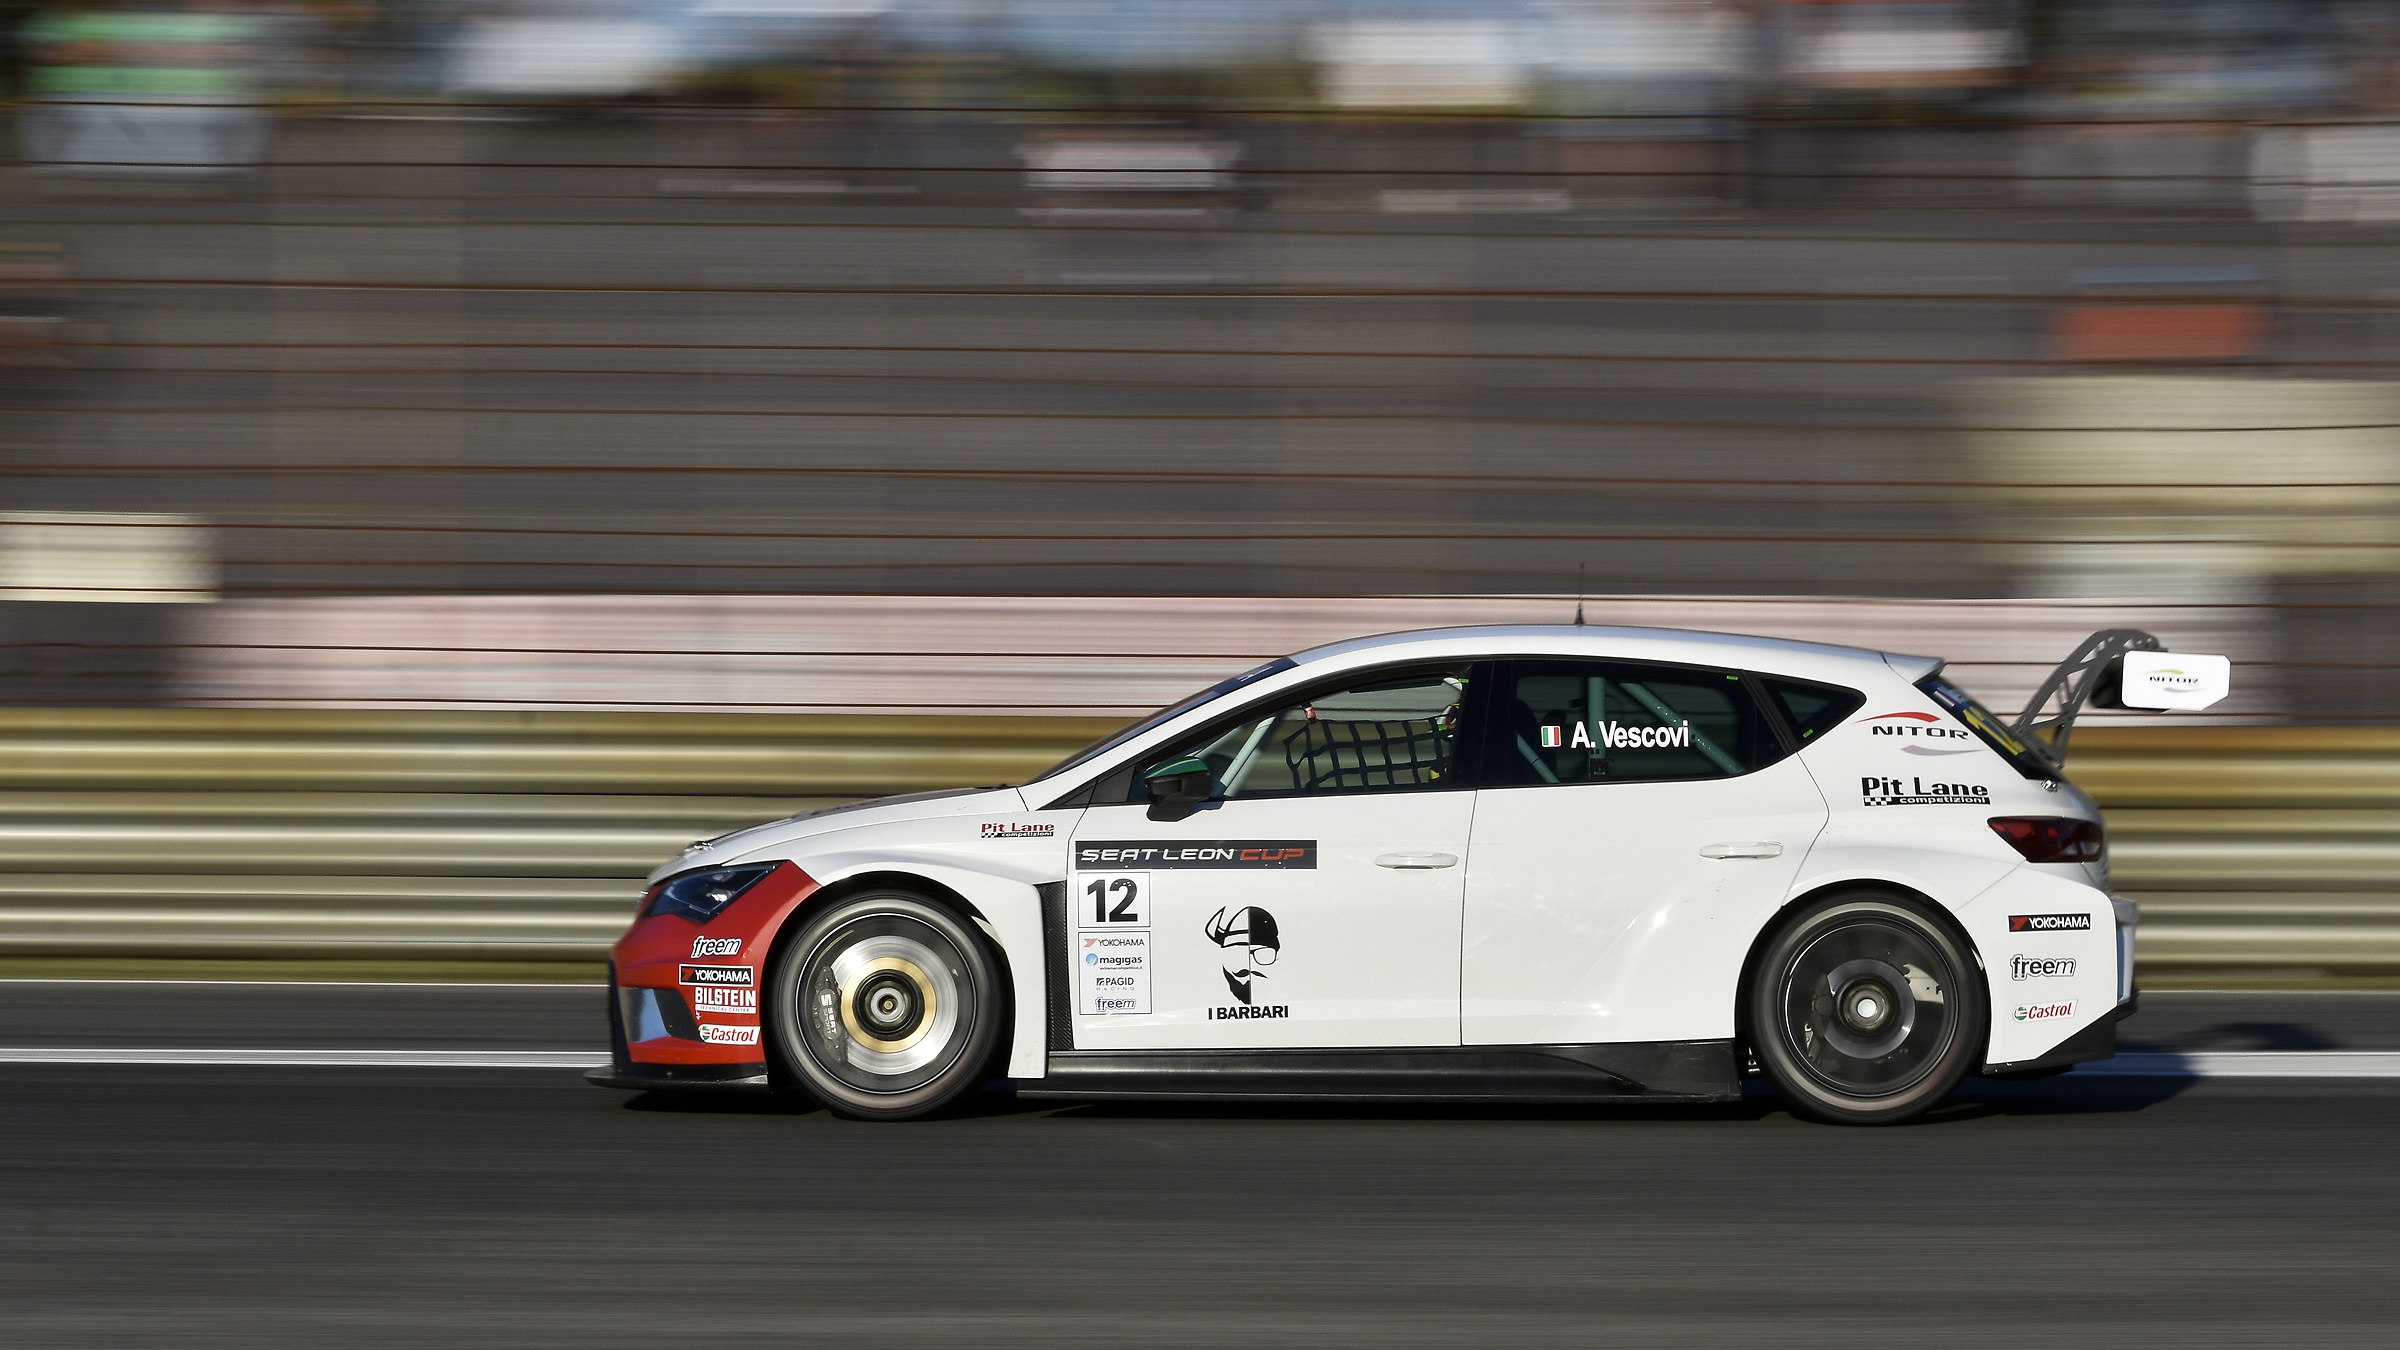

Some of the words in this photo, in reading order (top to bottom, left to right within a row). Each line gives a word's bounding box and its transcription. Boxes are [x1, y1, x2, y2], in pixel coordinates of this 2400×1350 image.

[1571, 721, 1596, 748] A.
[1598, 720, 1689, 748] Vescovi
[1872, 726, 1969, 740] NITOR
[1861, 777, 1904, 796] Pit
[1913, 777, 1989, 796] Lane
[1899, 796, 1986, 804] competizioni
[981, 823, 1005, 833] Pit
[1011, 822, 1055, 832] Lane
[1081, 848, 1158, 862] SEAT
[1162, 848, 1235, 861] LEON
[1240, 848, 1305, 861] CUP
[1087, 878, 1138, 922] 12
[2028, 916, 2089, 929] YOKOHAMA
[692, 937, 742, 957] freem
[1098, 938, 1144, 946] YOKOHAMA
[1099, 957, 1143, 965] magigas
[2012, 957, 2075, 978] freem
[695, 969, 751, 982] YOKOHAMA
[1105, 977, 1134, 986] PAGID
[695, 987, 756, 1007] BILSTEIN
[1097, 998, 1135, 1011] freem
[2029, 1002, 2072, 1019] Castrol
[1208, 1008, 1213, 1020] I
[1217, 1006, 1289, 1019] BARBARI
[711, 1027, 754, 1042] Castrol
